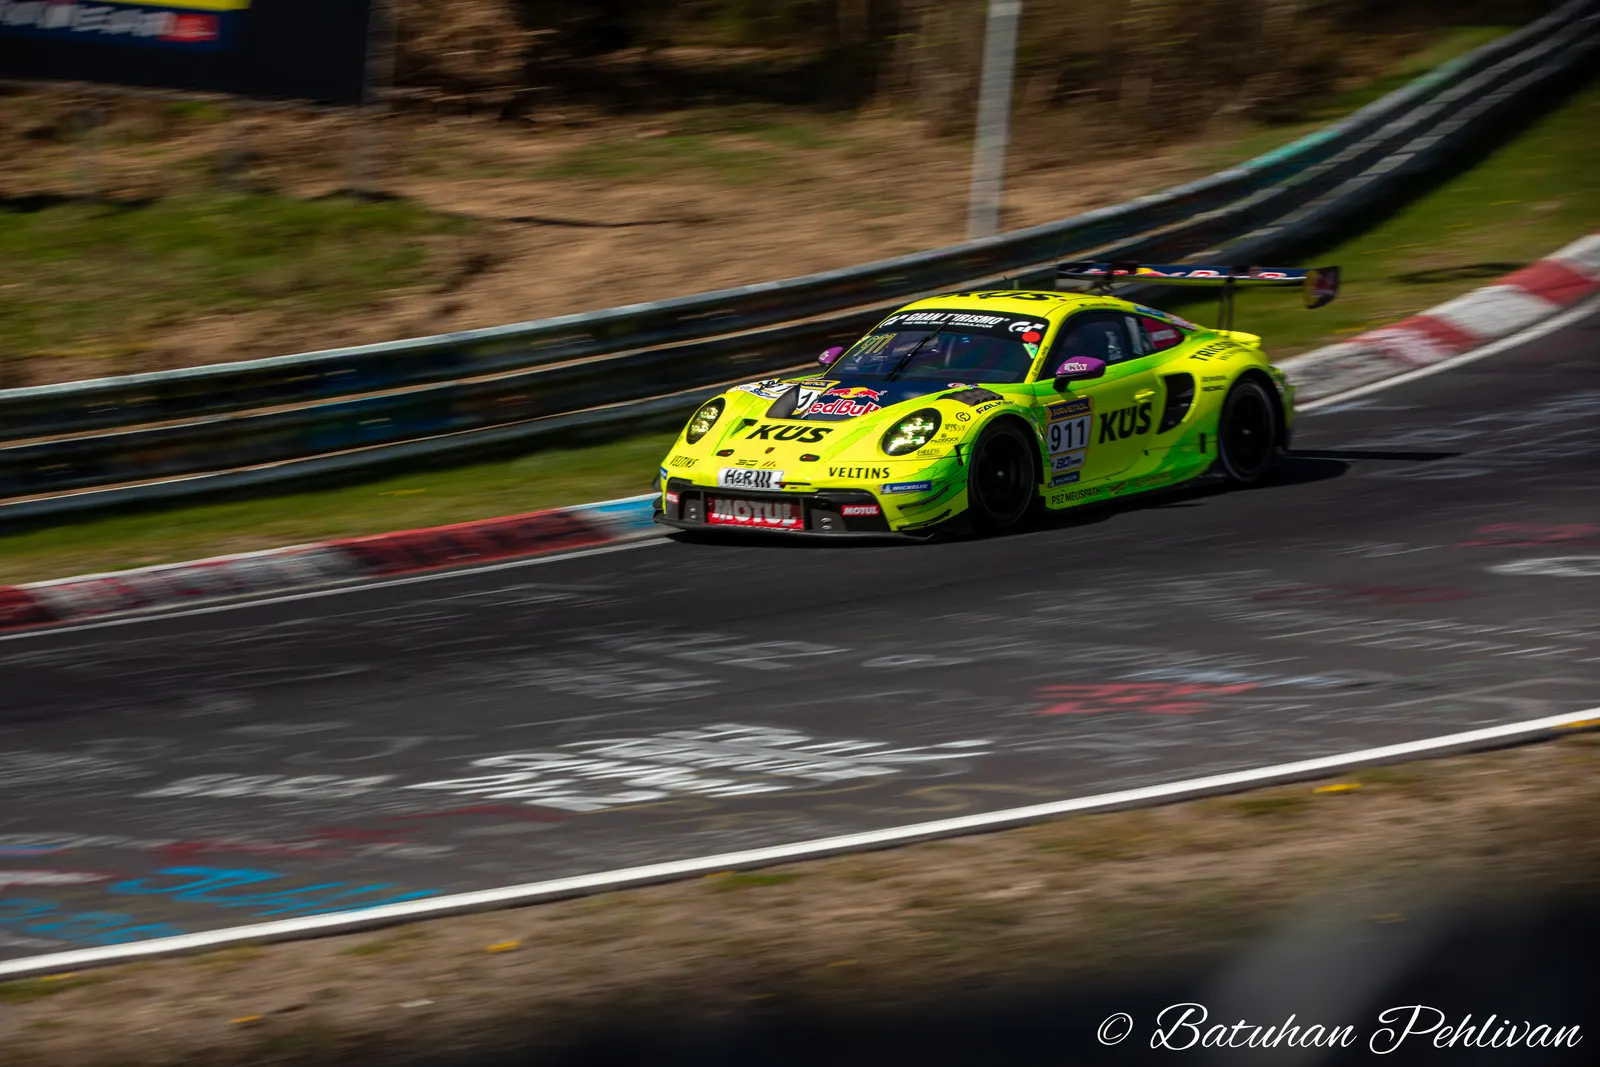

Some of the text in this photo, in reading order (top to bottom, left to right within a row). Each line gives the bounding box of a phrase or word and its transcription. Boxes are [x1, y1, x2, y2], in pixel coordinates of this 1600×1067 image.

[905, 312, 945, 322] GRAN
[1051, 419, 1085, 451] 911
[828, 467, 890, 479] VELTINS
[712, 498, 797, 526] MOTUL
[843, 506, 878, 515] MOTUL
